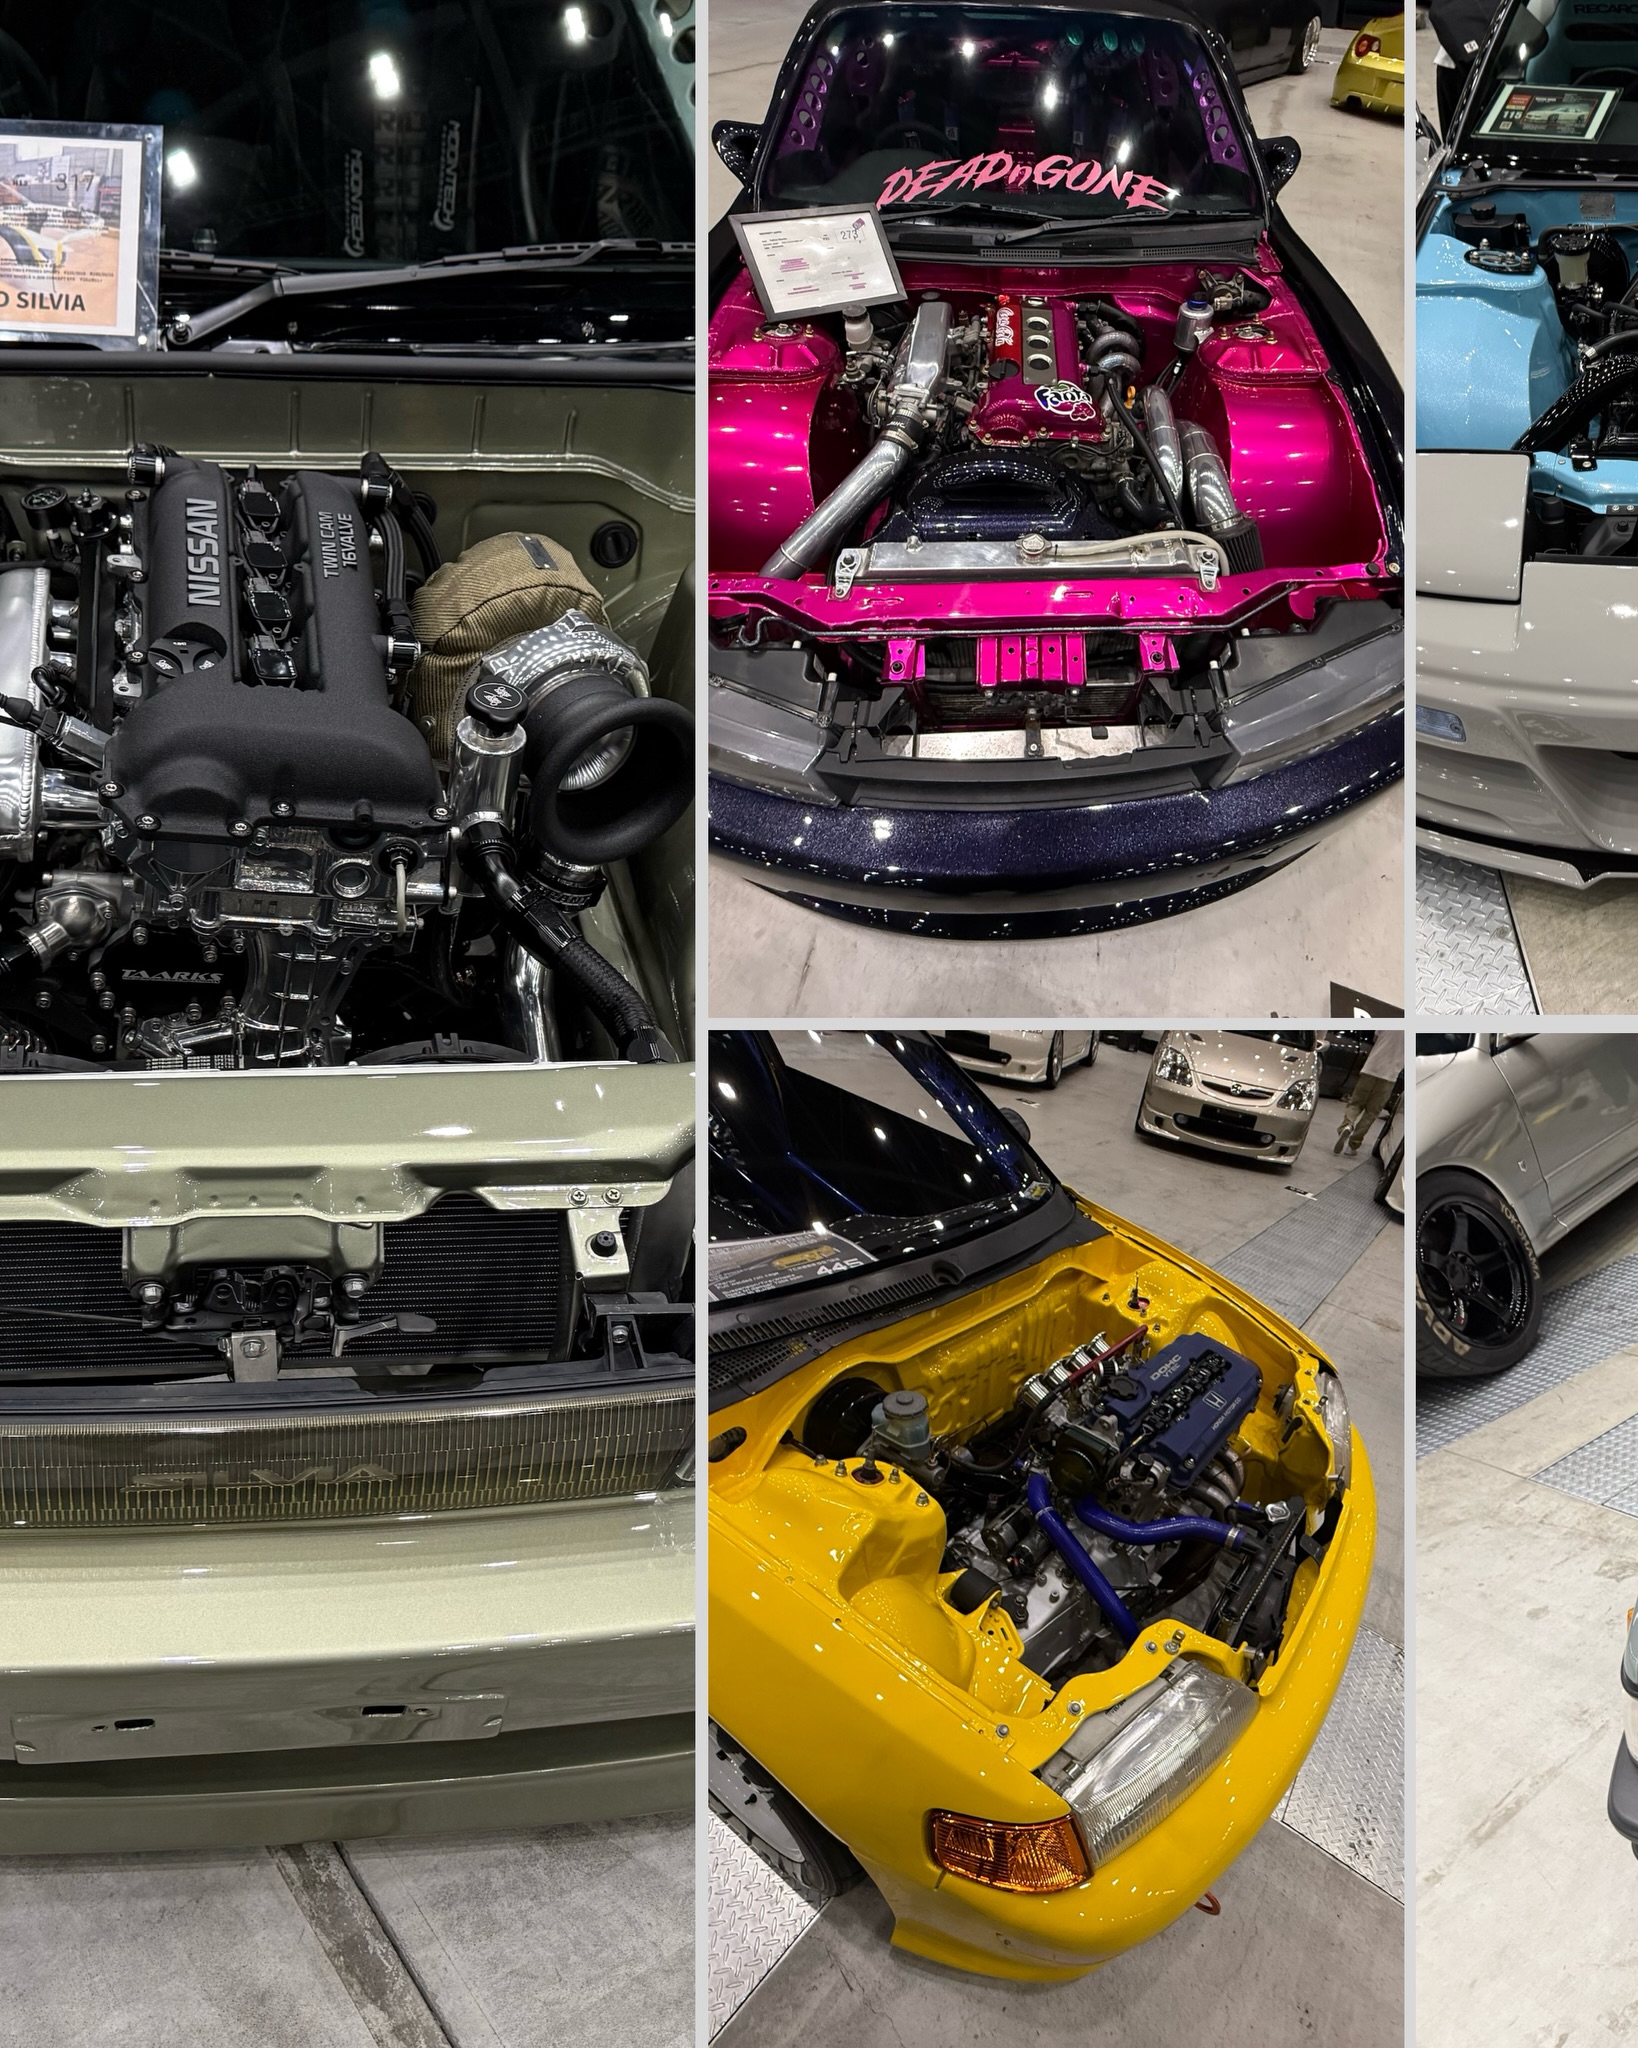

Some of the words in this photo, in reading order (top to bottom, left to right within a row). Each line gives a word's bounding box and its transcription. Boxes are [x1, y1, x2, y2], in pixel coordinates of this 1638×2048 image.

[56, 172, 95, 192] 317
[876, 150, 1181, 211] DEADnGONE
[840, 230, 859, 240] 273
[16, 291, 86, 312] SILVIA
[1034, 384, 1093, 411] Fanta
[318, 511, 336, 540] CAM
[186, 497, 221, 606] NISSAN
[321, 542, 340, 579] TWIN
[121, 968, 224, 982] TAARKS
[1500, 1200, 1541, 1280] YOKOHAMA
[816, 1257, 864, 1276] 445
[1150, 1354, 1182, 1381] DOHC
[1162, 1363, 1181, 1379] VTEC
[1211, 1414, 1226, 1431] HONDA
